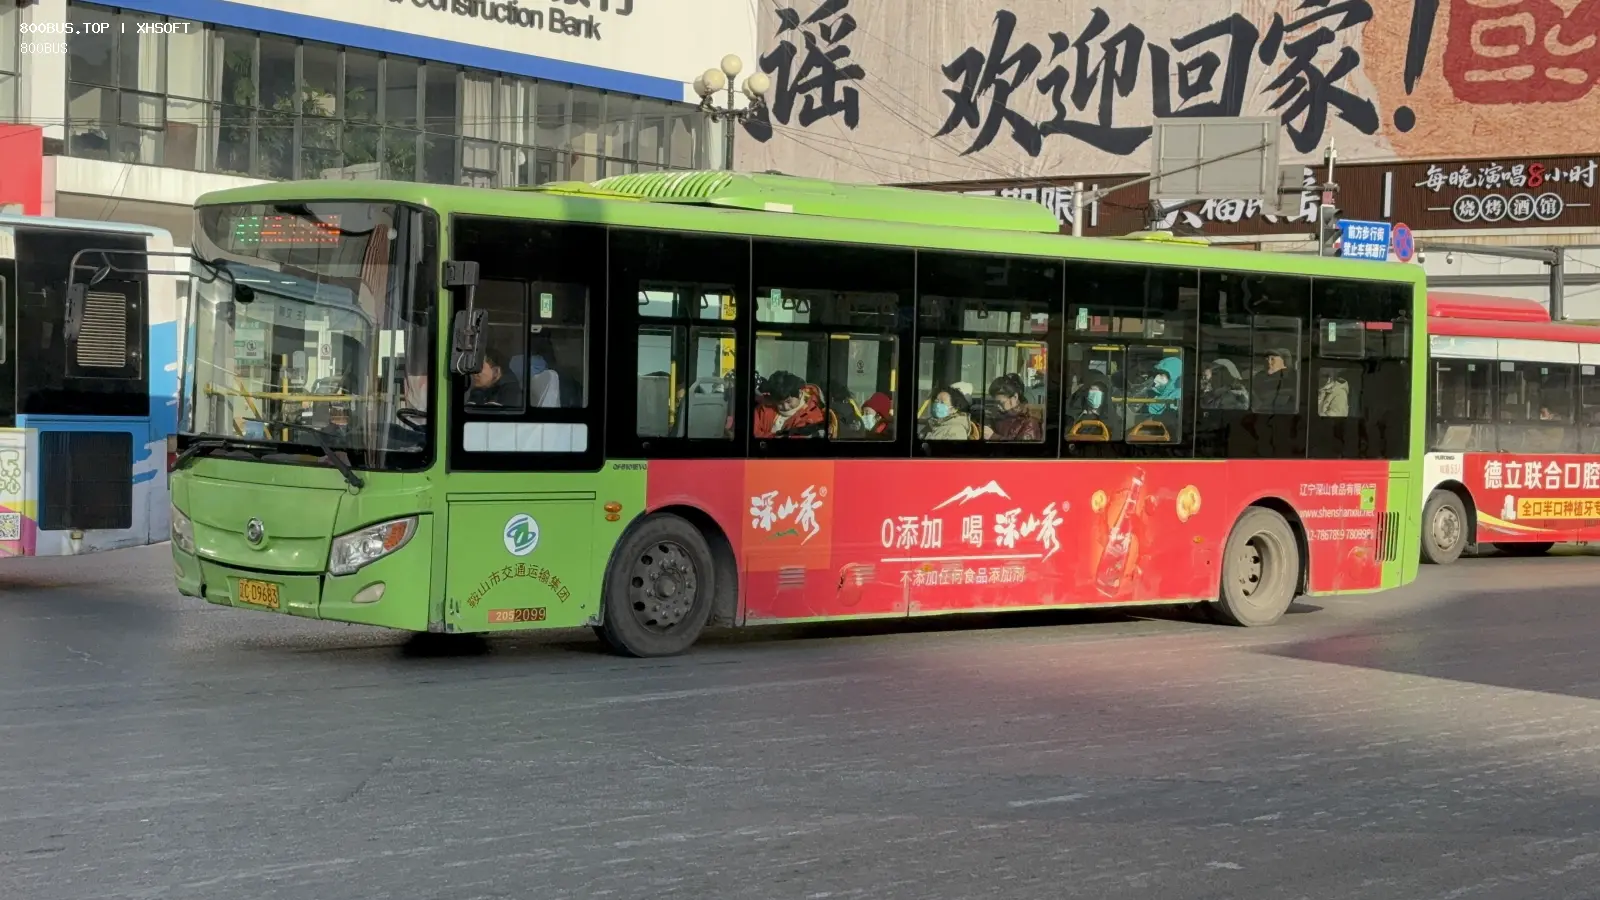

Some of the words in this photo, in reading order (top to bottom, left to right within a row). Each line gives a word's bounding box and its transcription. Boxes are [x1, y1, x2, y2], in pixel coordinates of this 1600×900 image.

[549, 7, 601, 41] Bank
[1415, 159, 1598, 192] 每晚演唱8小时
[1456, 197, 1560, 219] 烧烤酒馆
[1348, 225, 1385, 242] 前方步行街
[1343, 241, 1387, 258] 禁止车辆通行
[1484, 460, 1600, 490] 德立联合口腔
[881, 514, 943, 550] 0添加
[961, 514, 984, 549] 喝
[467, 562, 571, 608] 鞍山市交通运输集团
[900, 566, 1025, 587] 不添加任何食品添加剂
